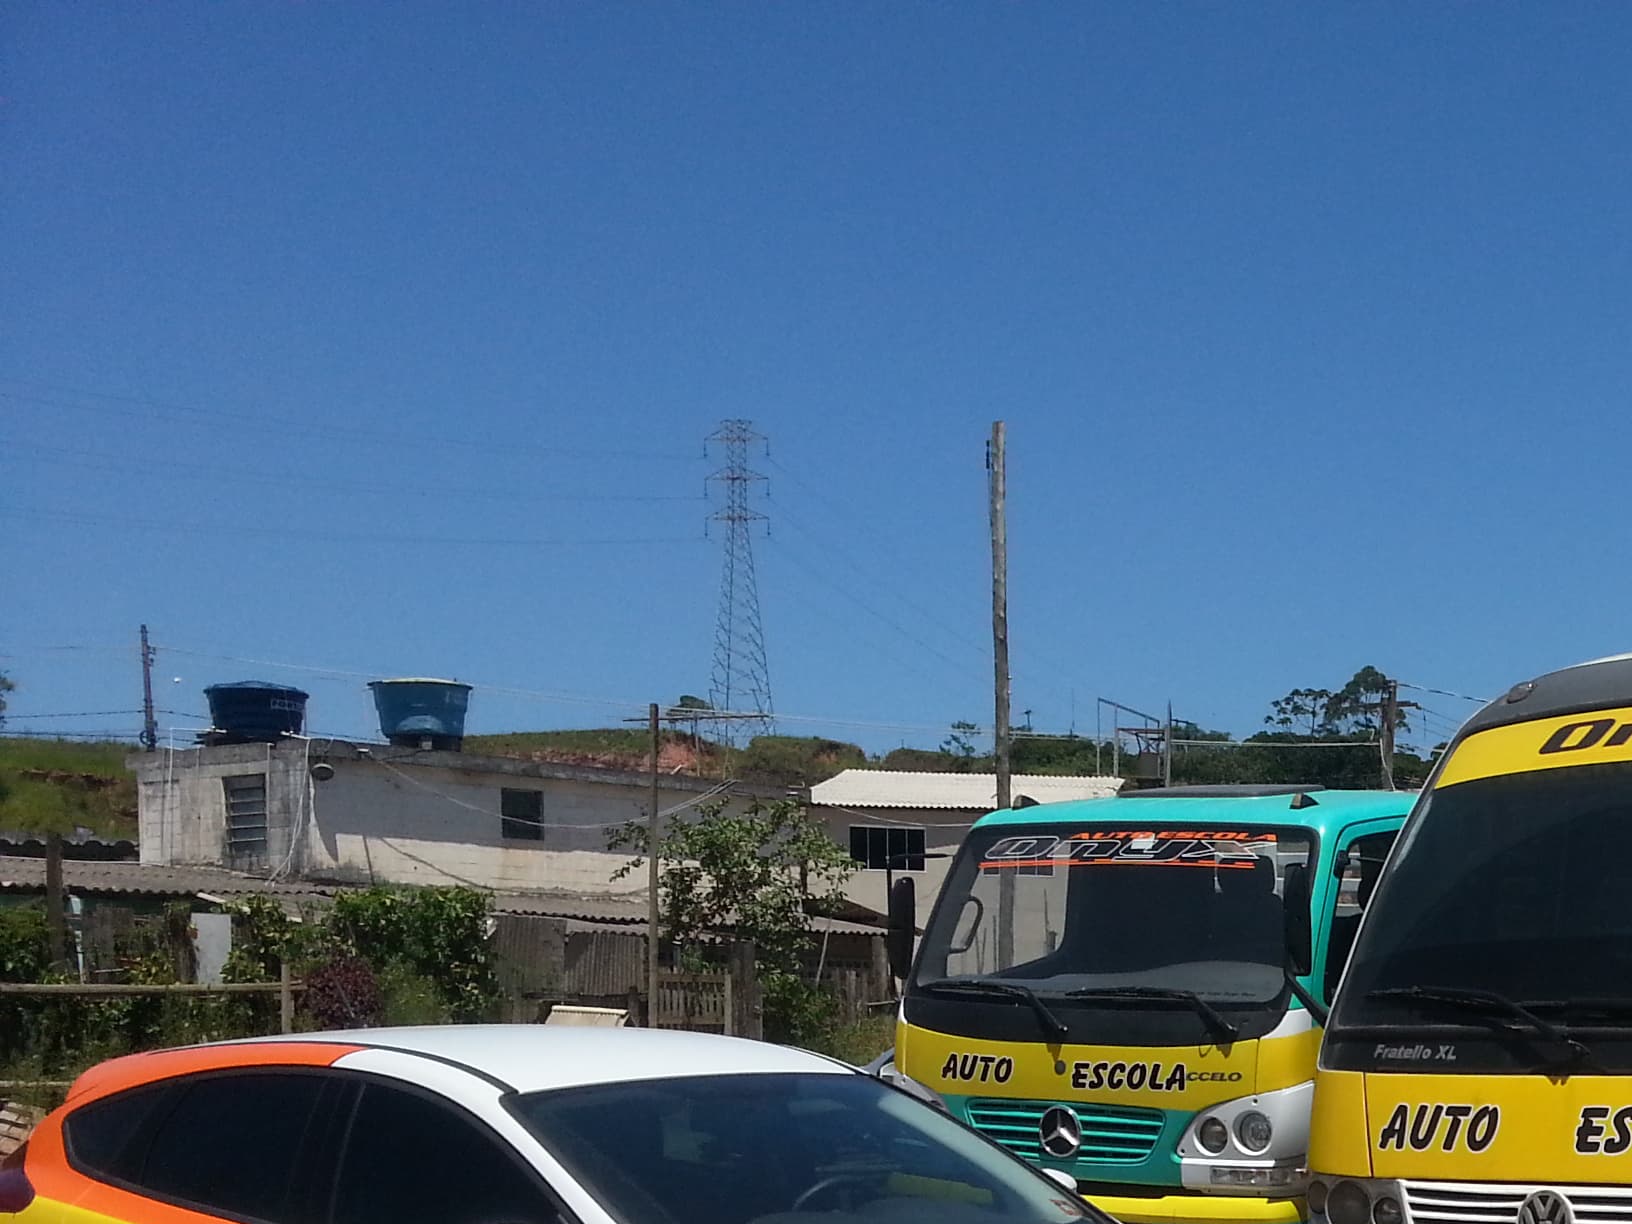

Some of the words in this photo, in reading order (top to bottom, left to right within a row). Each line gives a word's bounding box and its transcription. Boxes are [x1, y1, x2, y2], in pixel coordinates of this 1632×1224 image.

[1069, 831, 1151, 840] AUTO
[1153, 831, 1277, 840] ESCOLA
[985, 836, 1277, 861] Onyx
[1374, 1044, 1432, 1060] Fratello
[1435, 1045, 1457, 1060] XL
[941, 1052, 1015, 1084] AUTO
[1072, 1062, 1186, 1091] ESCOLA
[1378, 1103, 1500, 1154] AUTO
